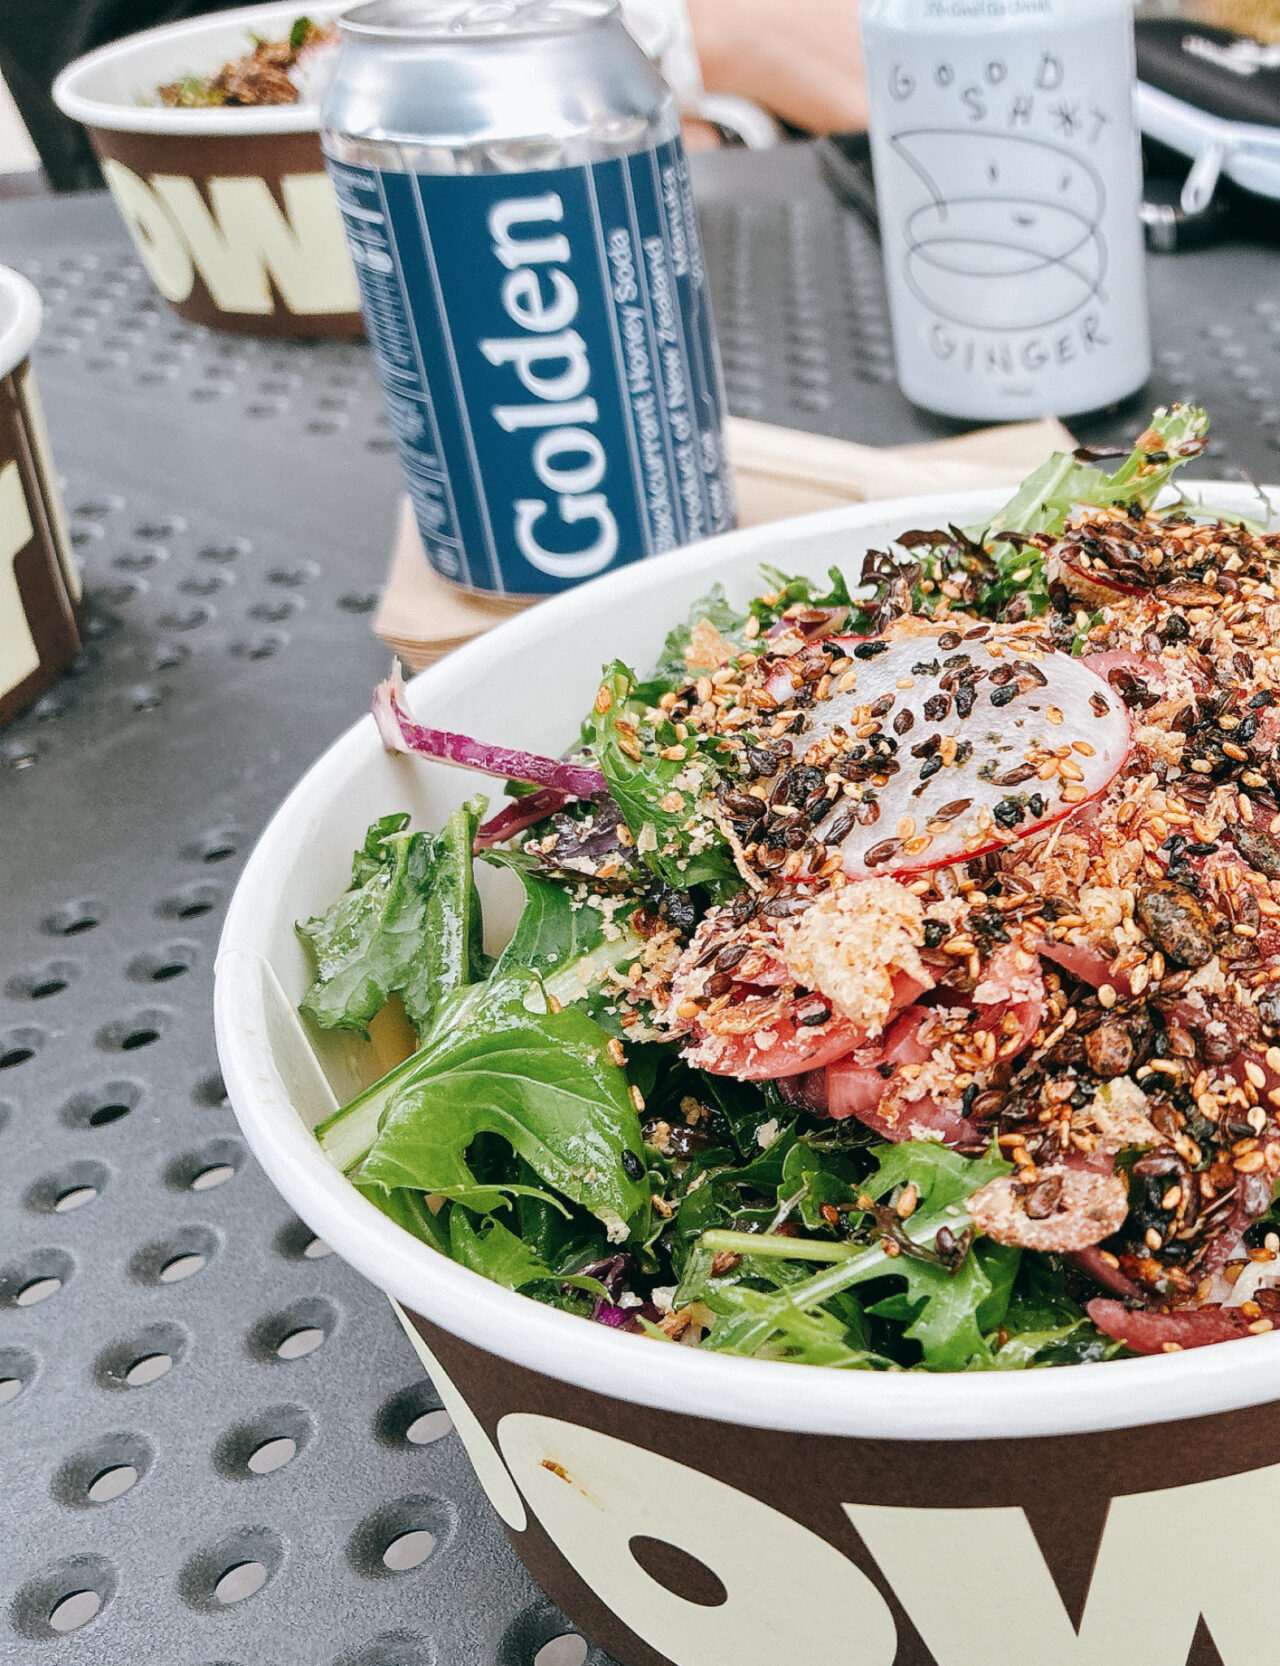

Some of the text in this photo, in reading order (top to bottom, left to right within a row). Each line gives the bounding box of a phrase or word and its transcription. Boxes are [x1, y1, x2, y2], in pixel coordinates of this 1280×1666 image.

[888, 52, 1065, 101] GOOD
[608, 228, 638, 304] Soda
[642, 233, 678, 347] Zealand
[618, 304, 652, 394] Honey
[662, 346, 686, 409] New
[929, 316, 1111, 376] GINGER
[478, 191, 618, 579] Golden
[669, 411, 691, 441] of
